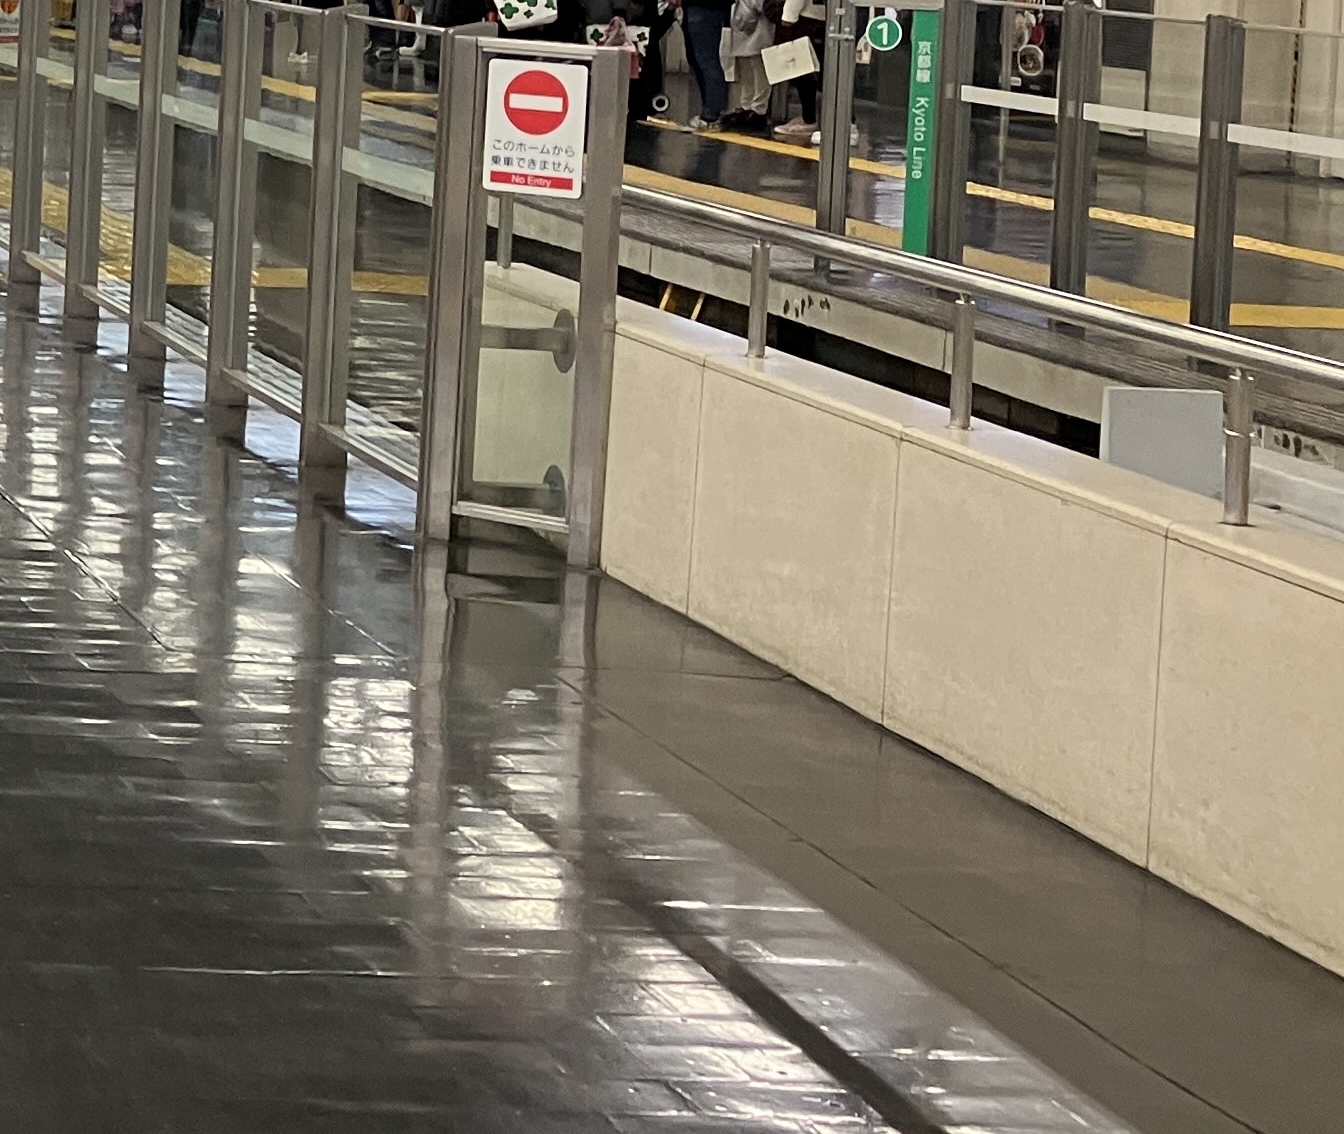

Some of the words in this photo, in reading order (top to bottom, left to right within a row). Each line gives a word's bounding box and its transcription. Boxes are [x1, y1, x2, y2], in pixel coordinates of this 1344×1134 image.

[877, 21, 889, 46] 1
[915, 41, 932, 83] 京都線
[912, 97, 930, 142] Kyoto
[492, 139, 575, 158] このホームから
[491, 155, 574, 174] 乗車できません
[911, 147, 926, 179] Line
[511, 174, 525, 185] No
[527, 176, 552, 188] Entry
